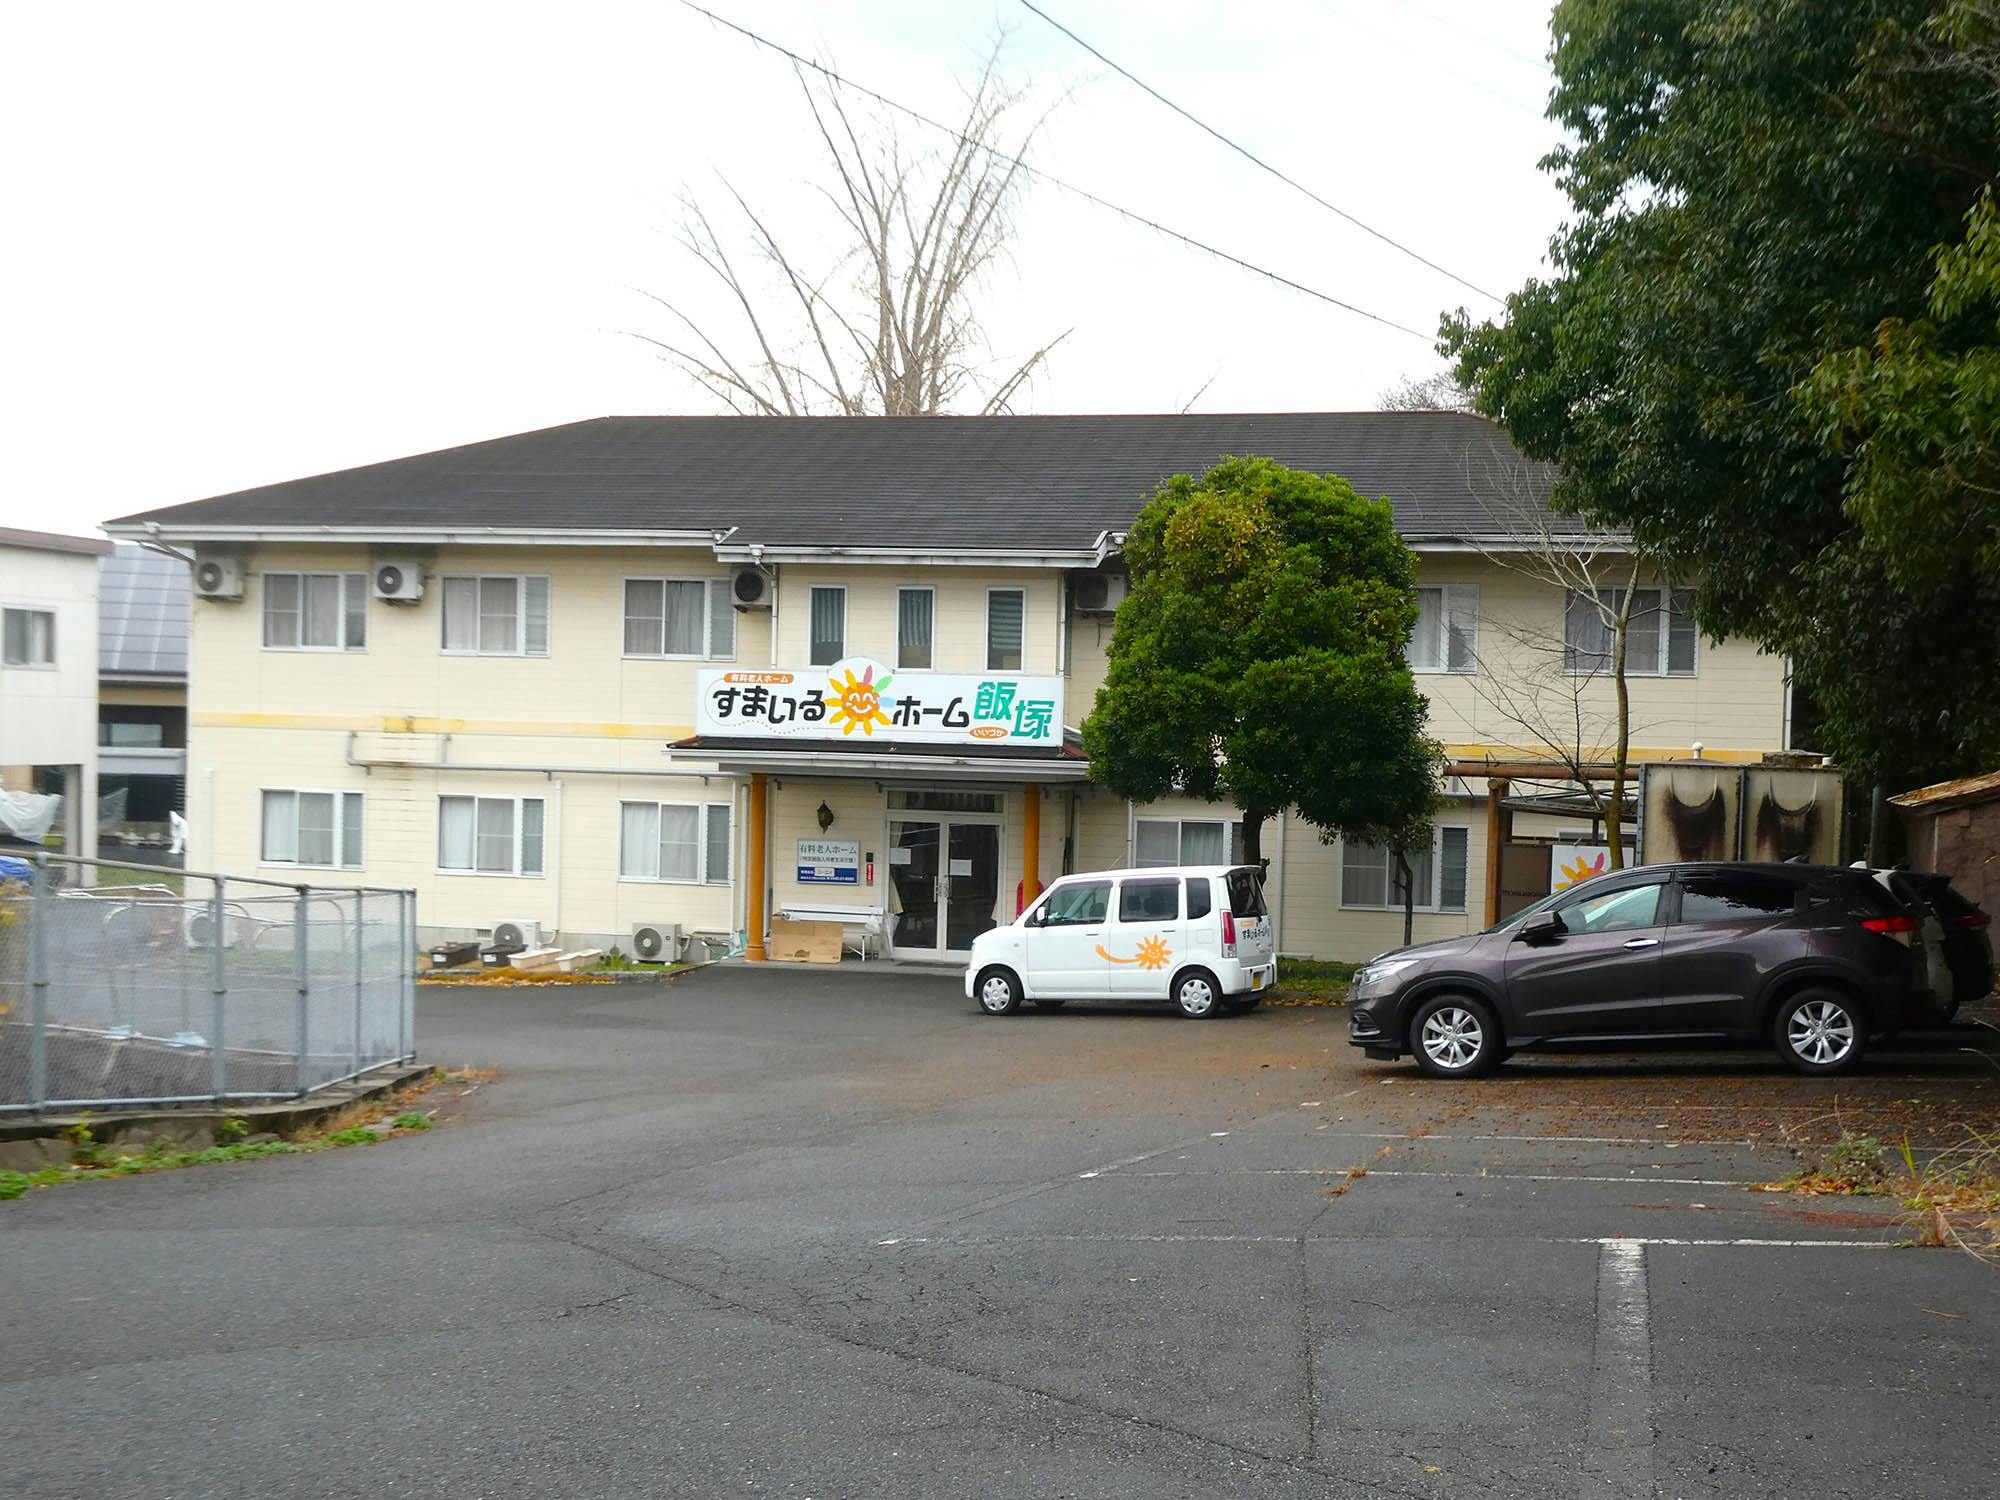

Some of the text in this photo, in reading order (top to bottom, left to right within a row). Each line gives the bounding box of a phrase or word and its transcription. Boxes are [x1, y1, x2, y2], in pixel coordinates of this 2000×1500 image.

[713, 681, 1055, 740] すまいる ホーム 飯塚
[800, 844, 857, 854] 有料老人ホーム
